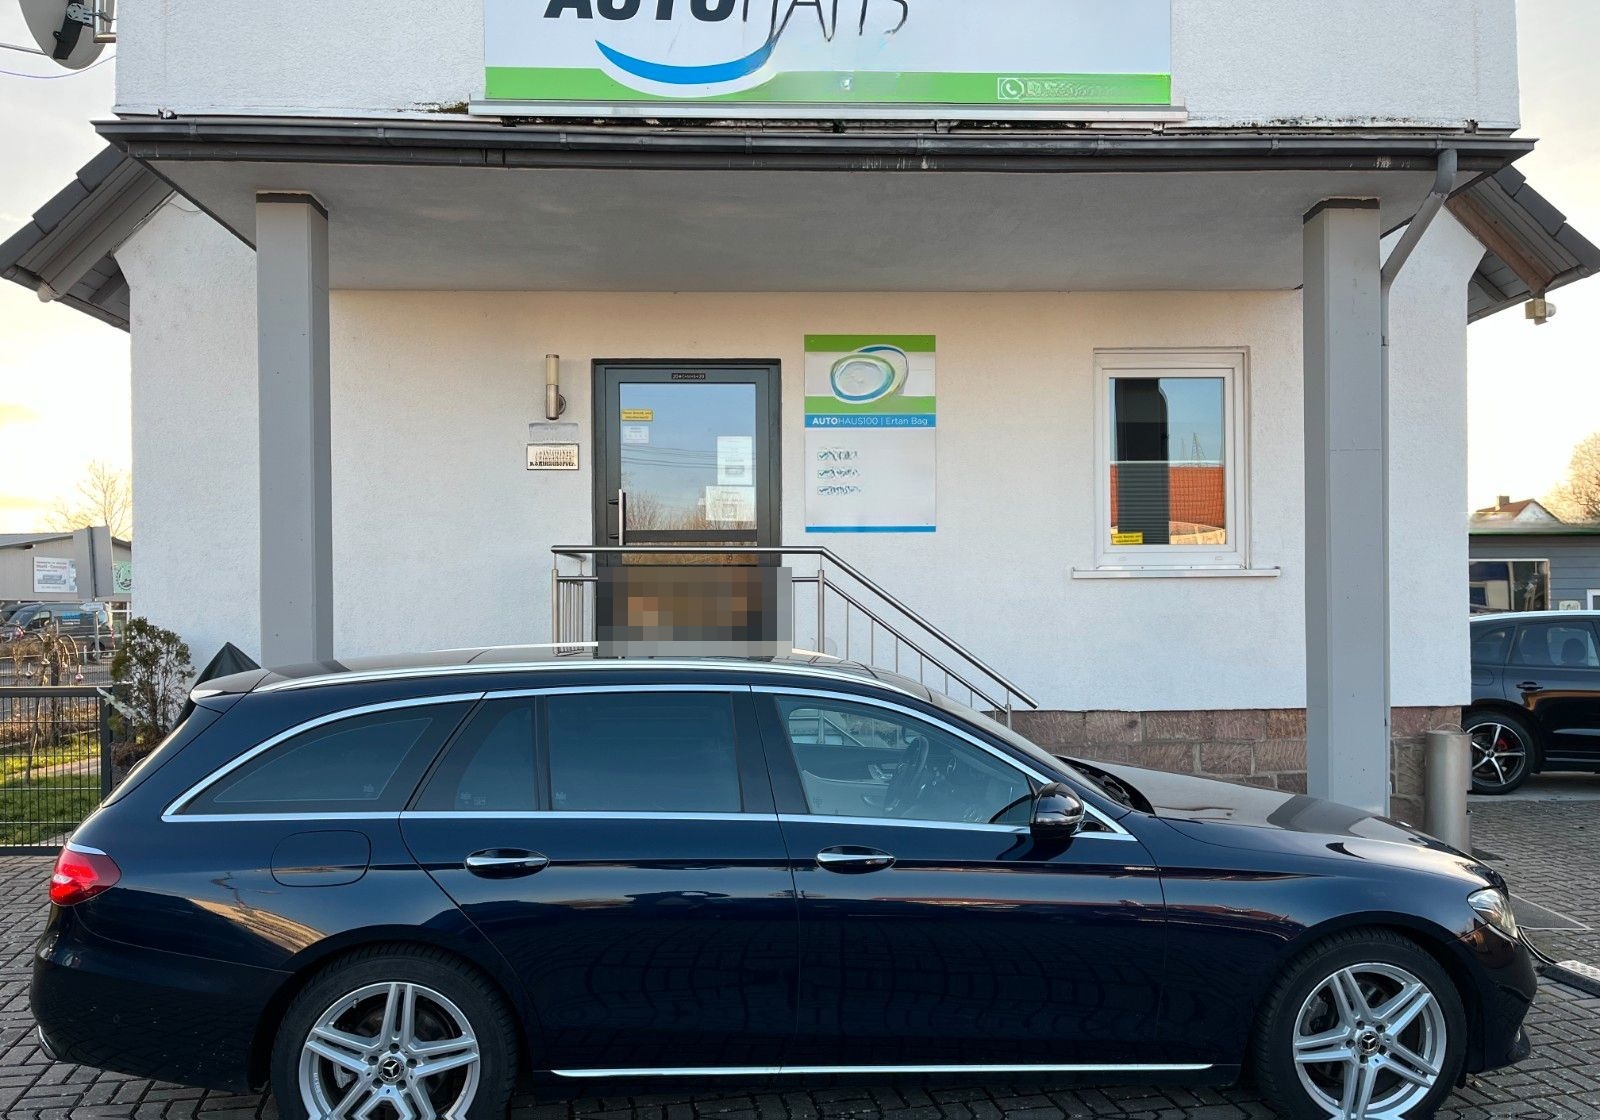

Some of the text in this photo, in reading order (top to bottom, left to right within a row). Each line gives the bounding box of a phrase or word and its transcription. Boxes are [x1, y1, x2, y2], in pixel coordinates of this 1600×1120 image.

[812, 417, 879, 425] AUTOHAUS100
[885, 417, 909, 425] Ertan
[911, 416, 928, 426] Bag
